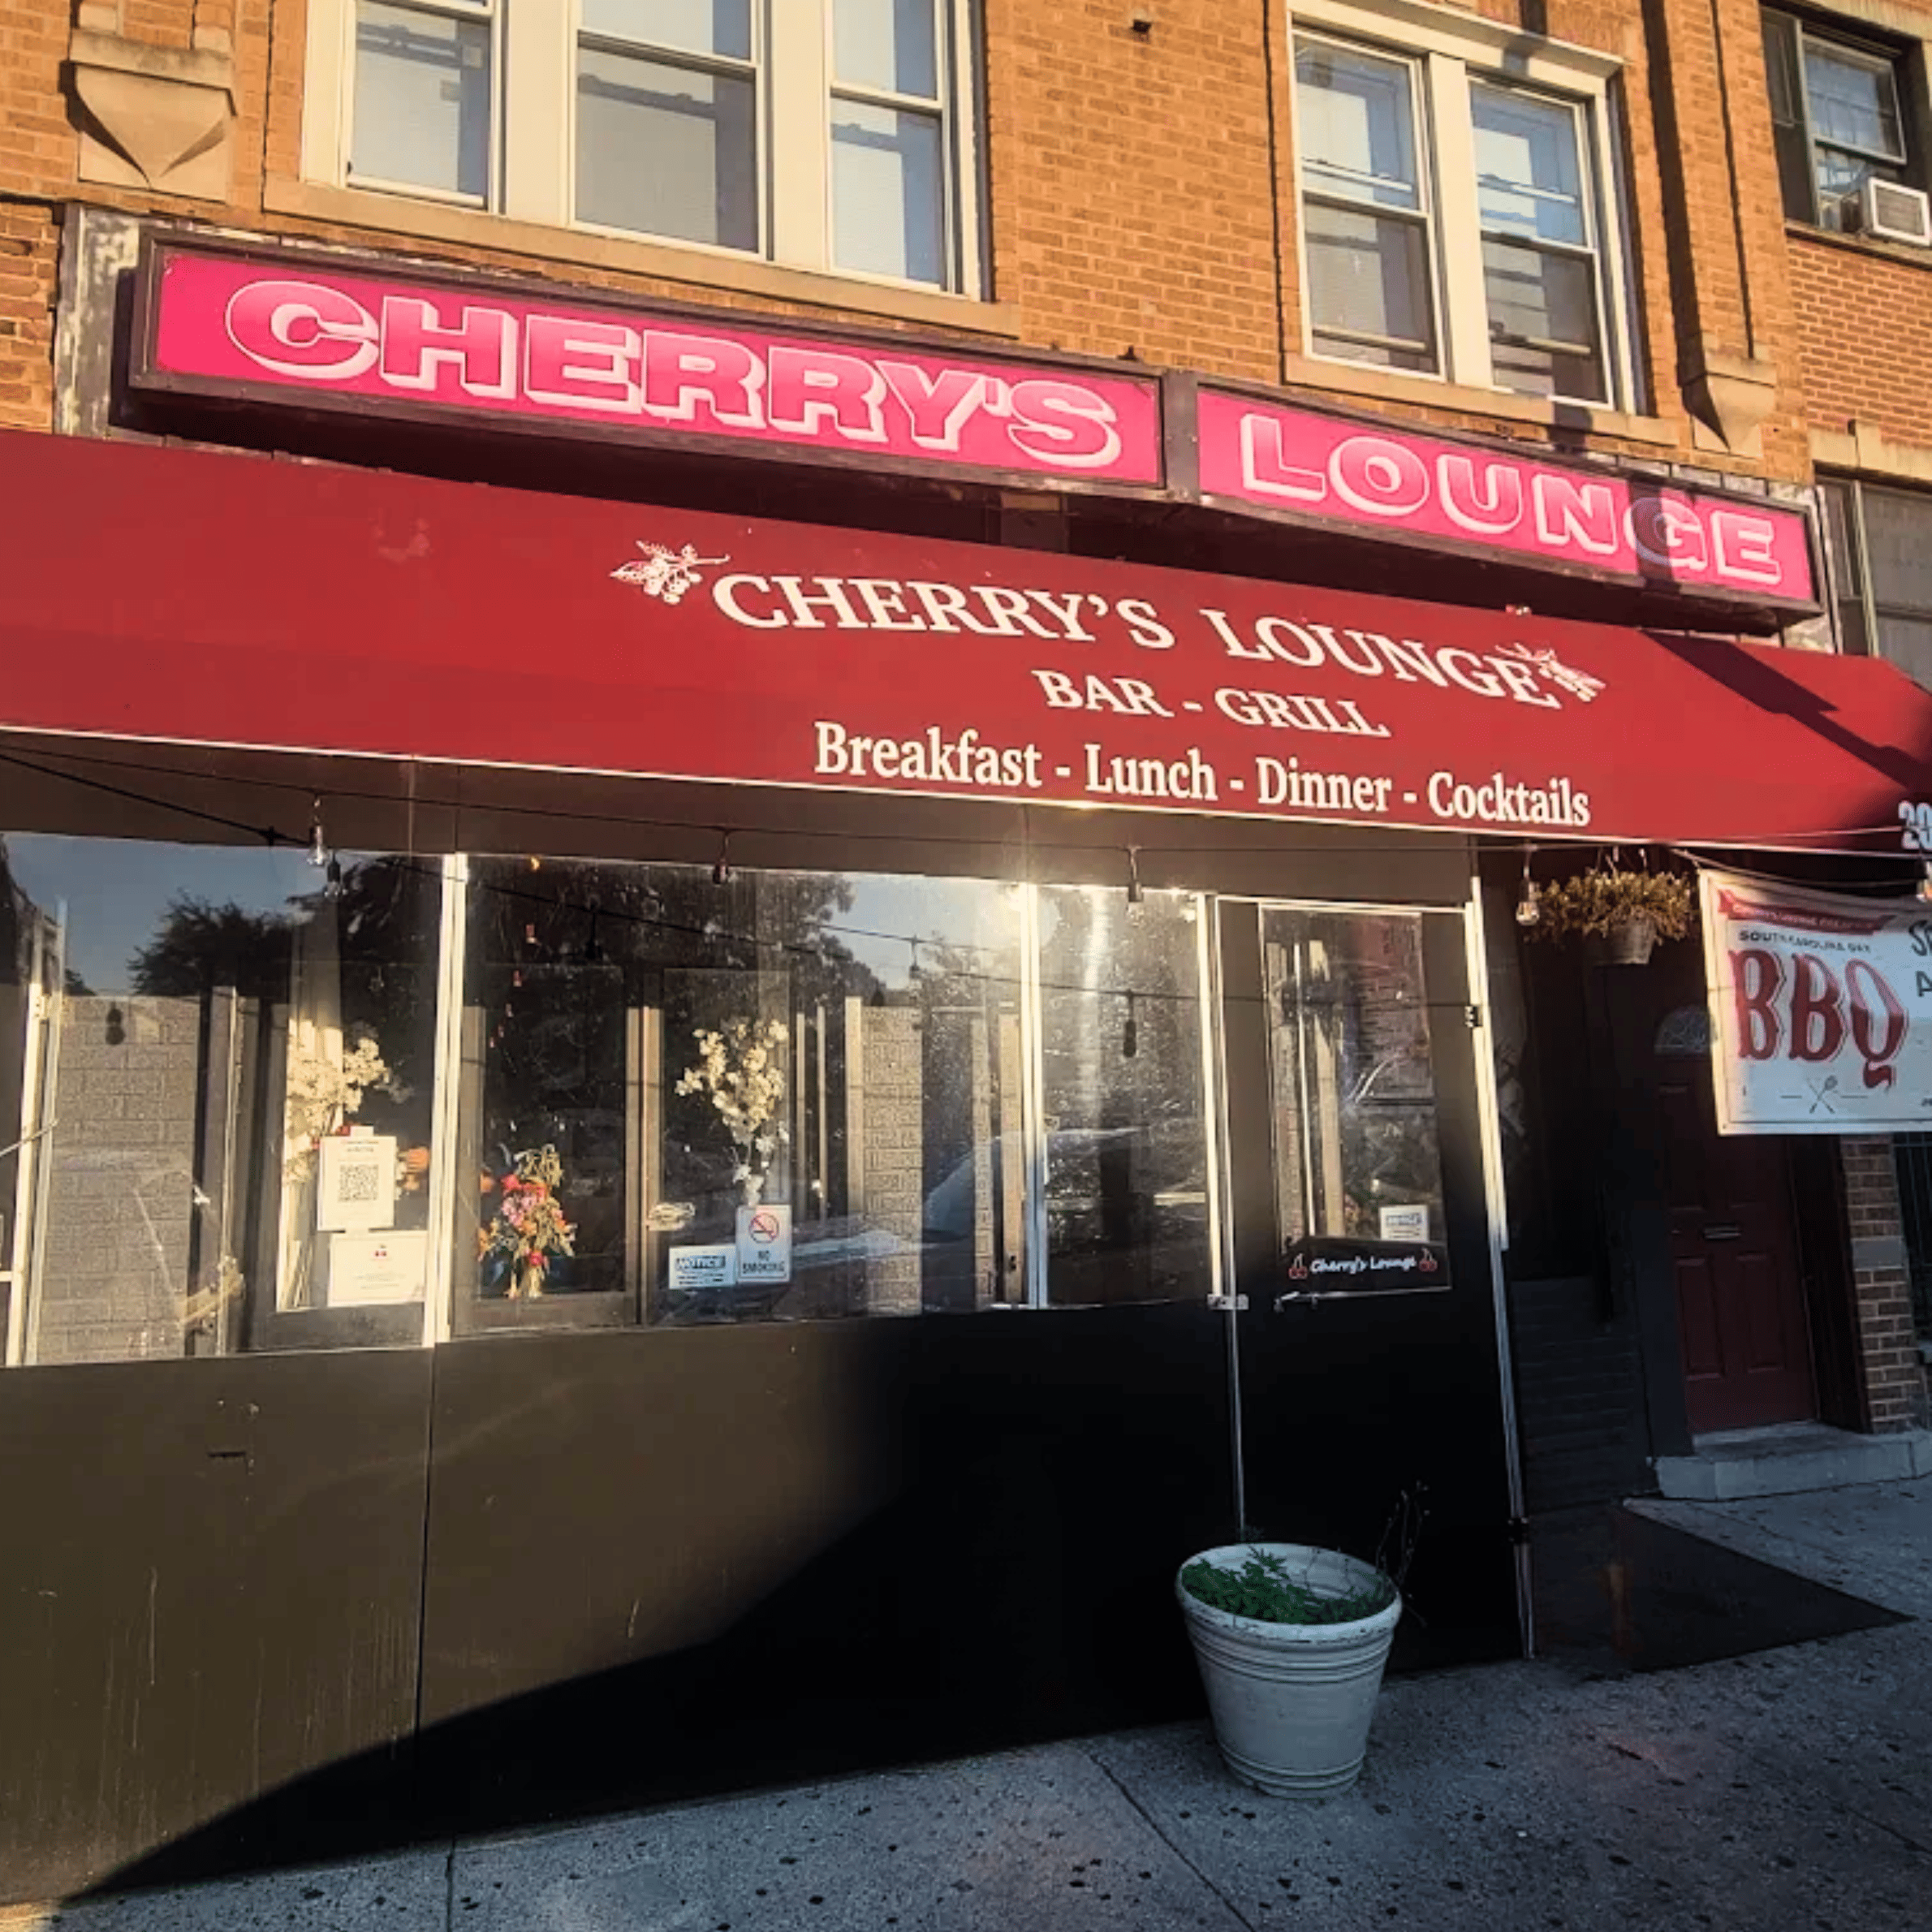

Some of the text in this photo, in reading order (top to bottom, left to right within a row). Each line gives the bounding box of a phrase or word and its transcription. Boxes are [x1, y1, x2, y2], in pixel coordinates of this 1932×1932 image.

[224, 279, 1782, 586] CHERRY'S LOUNGE
[712, 573, 1563, 709] CHERRY'S LOUNGE
[1031, 669, 1175, 718] BAR
[1214, 688, 1393, 738] GRILL
[813, 720, 1043, 788] Breakfast
[1084, 743, 1218, 801] Lunch
[1255, 755, 1393, 813] Dinner
[1427, 771, 1592, 827] Cocktails
[1727, 948, 1910, 1091] BBQ
